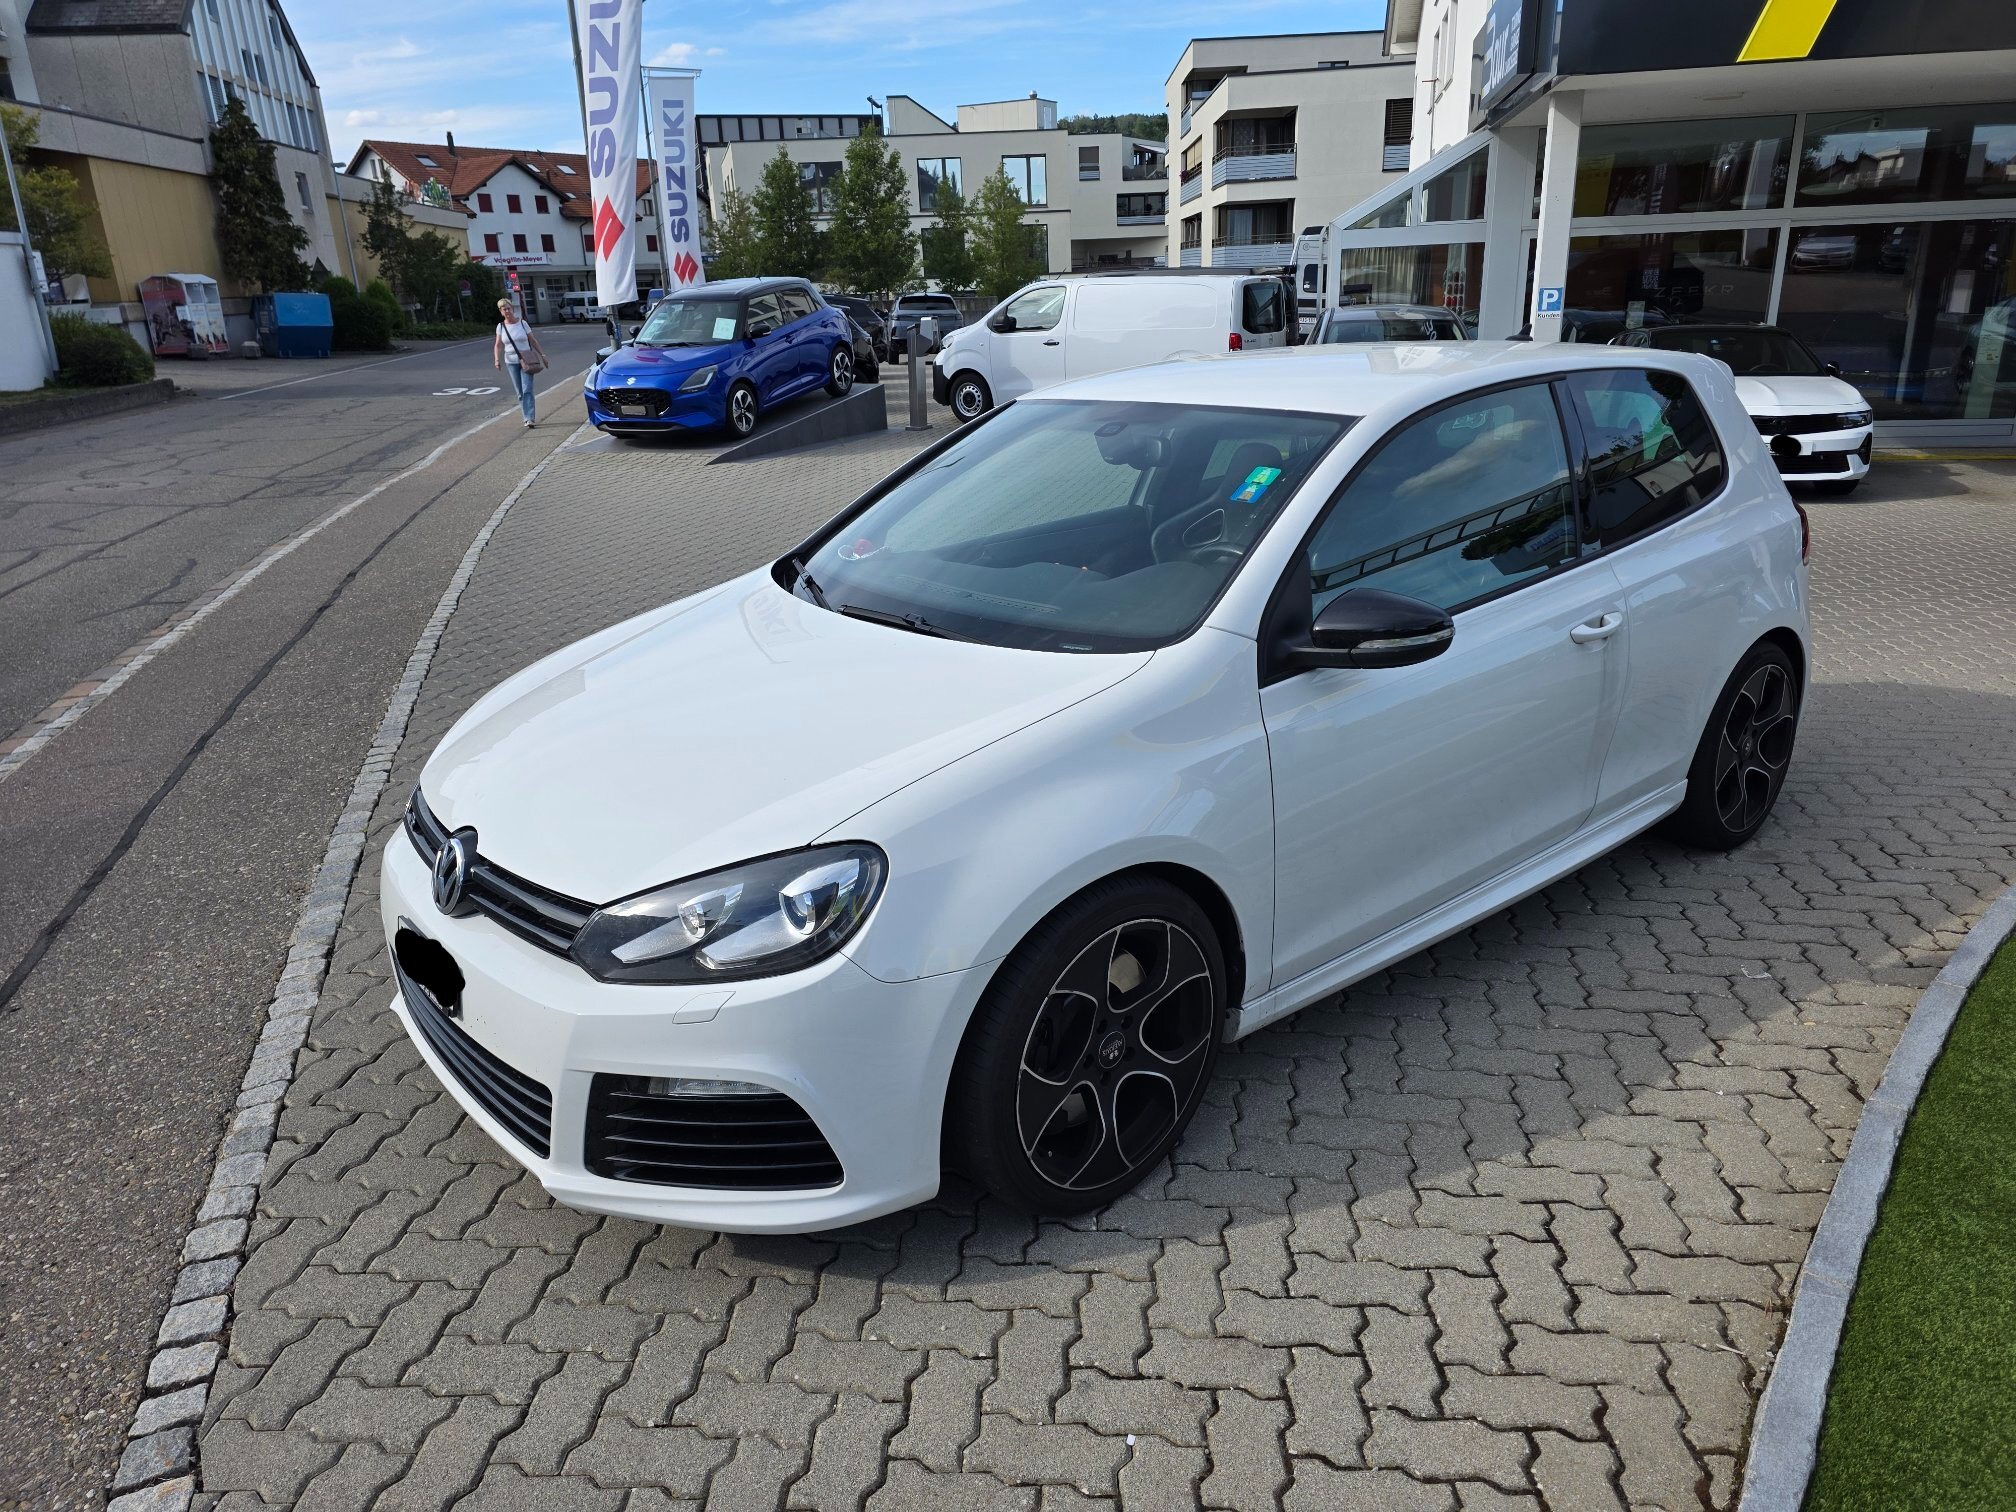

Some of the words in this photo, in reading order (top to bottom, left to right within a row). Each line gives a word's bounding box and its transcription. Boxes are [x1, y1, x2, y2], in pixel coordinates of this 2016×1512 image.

[662, 99, 690, 243] SUZUKI
[1541, 289, 1559, 310] P
[432, 386, 501, 396] 30
